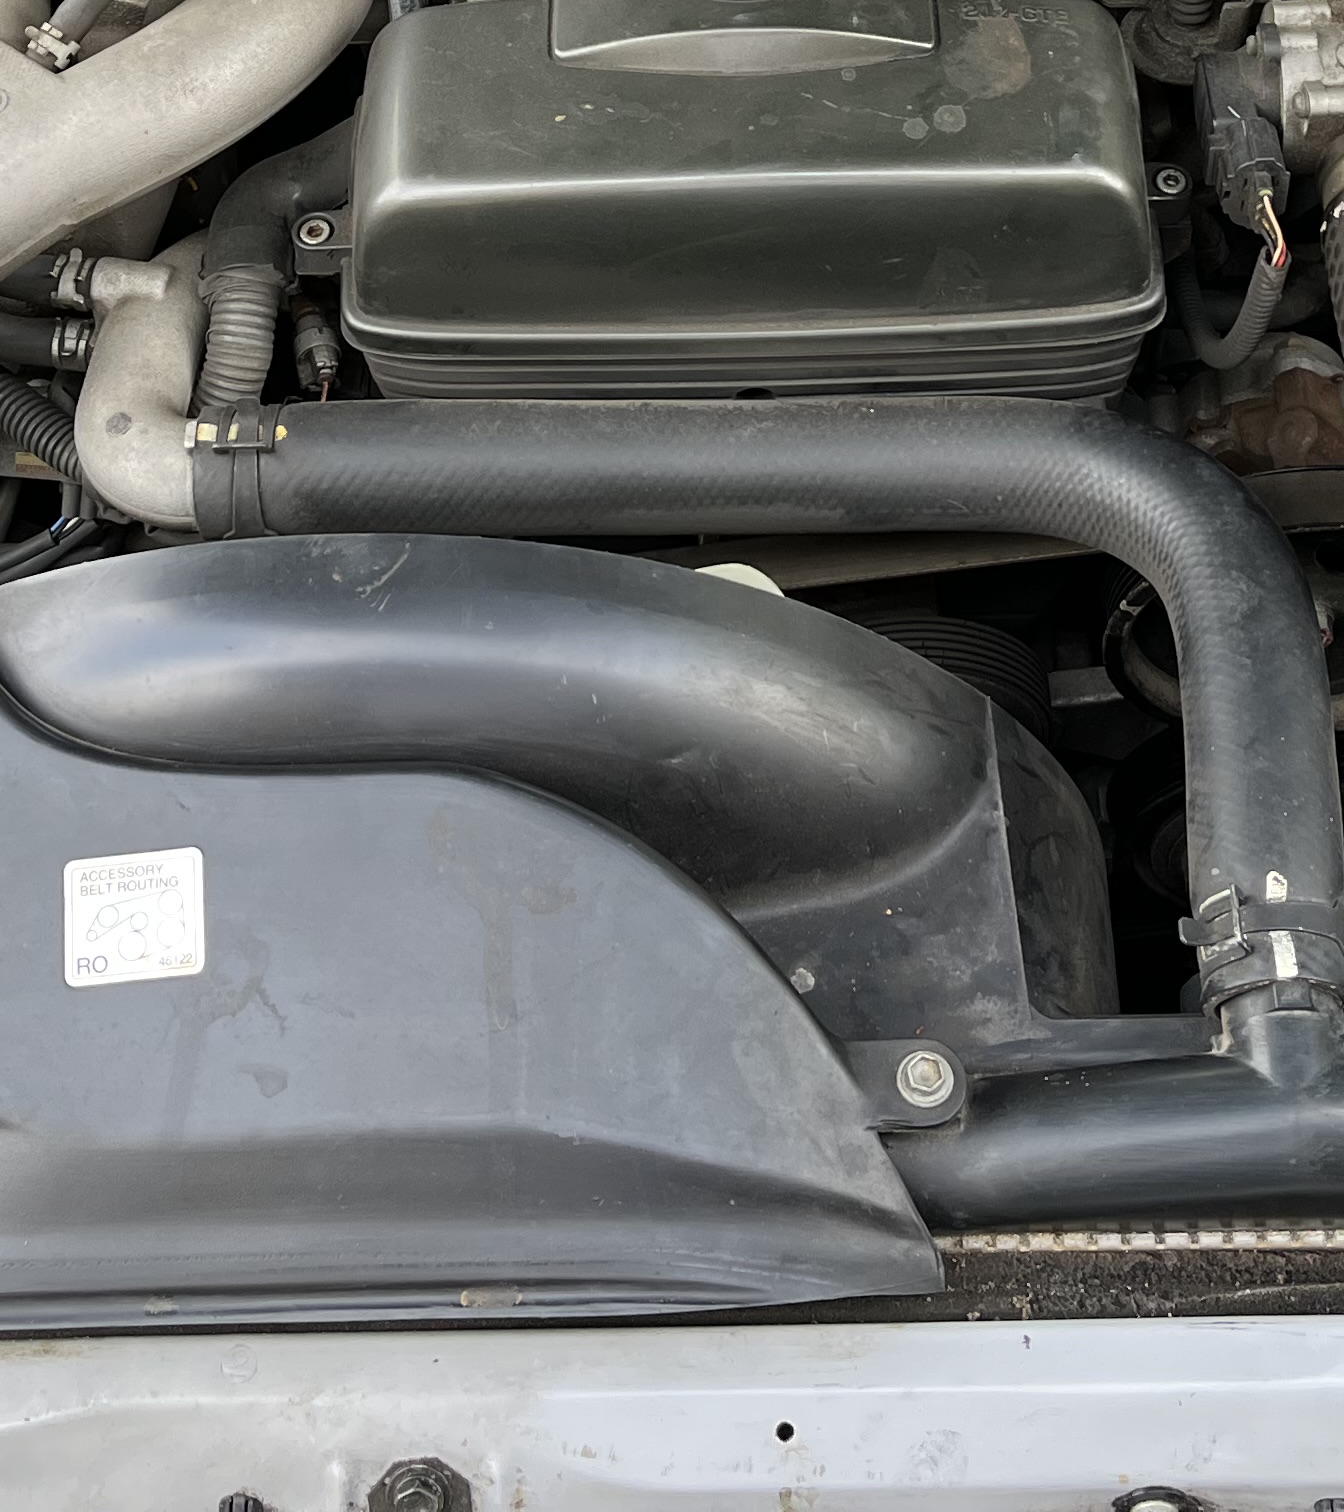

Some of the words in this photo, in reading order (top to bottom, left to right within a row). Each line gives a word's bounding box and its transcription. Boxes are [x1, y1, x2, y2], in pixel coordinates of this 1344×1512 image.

[80, 864, 164, 883] ACCESSORY
[80, 883, 113, 897] BELT
[117, 876, 179, 893] ROUTING
[77, 955, 109, 975] RO
